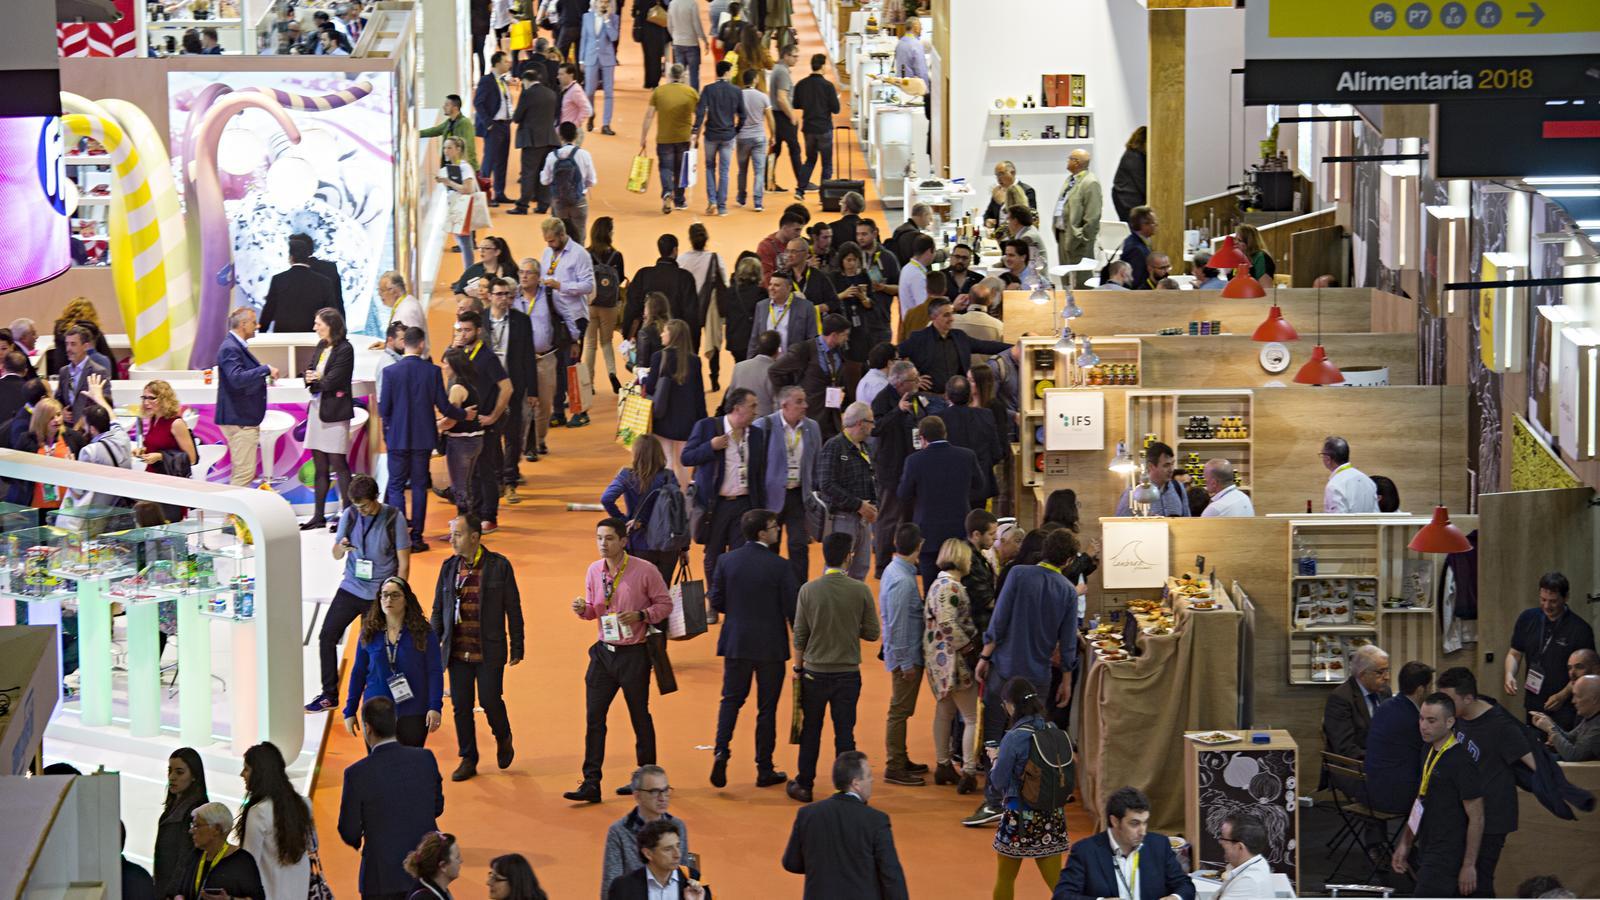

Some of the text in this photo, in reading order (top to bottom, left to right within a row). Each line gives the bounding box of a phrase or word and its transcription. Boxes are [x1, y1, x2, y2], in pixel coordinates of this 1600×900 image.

[1374, 10, 1429, 23] P6 P7
[1336, 69, 1533, 91] Alimentaria 2018
[1072, 416, 1091, 426] IFS
